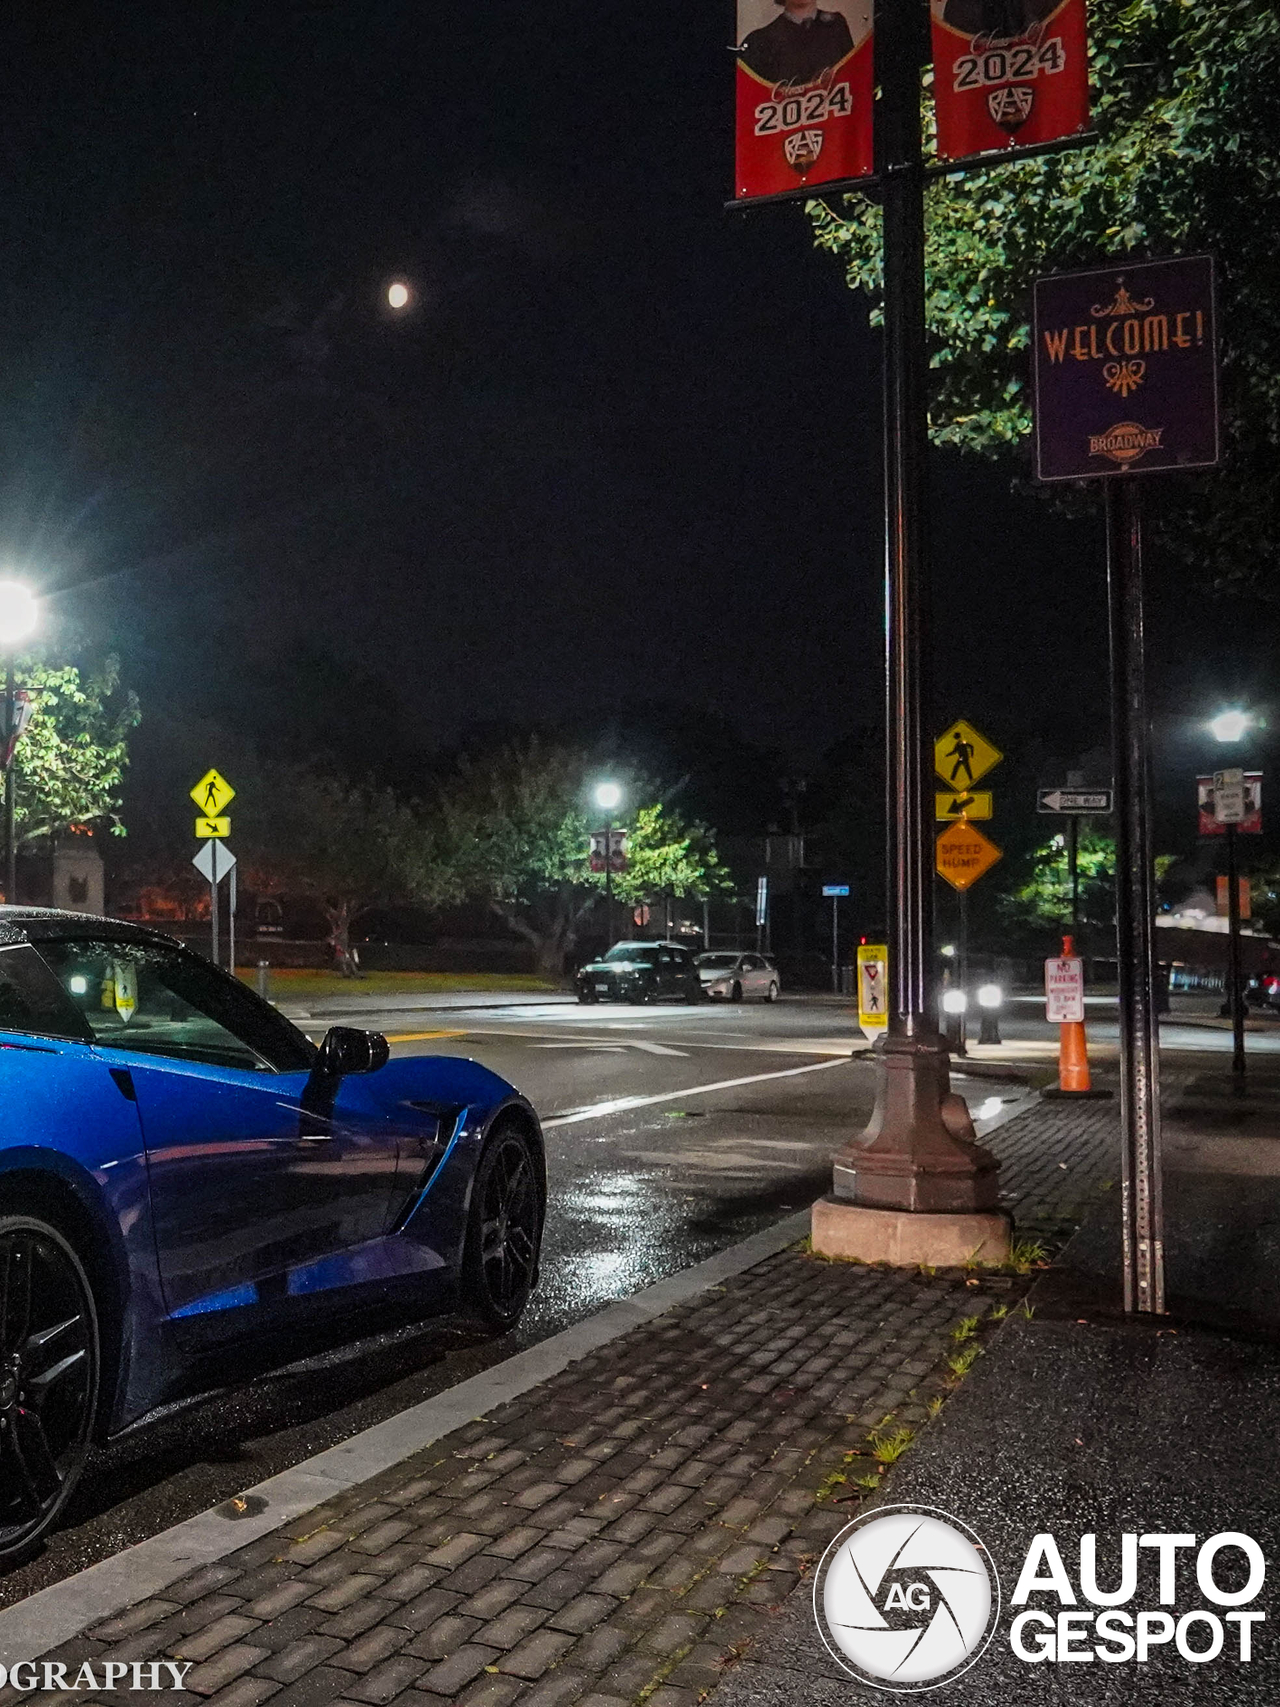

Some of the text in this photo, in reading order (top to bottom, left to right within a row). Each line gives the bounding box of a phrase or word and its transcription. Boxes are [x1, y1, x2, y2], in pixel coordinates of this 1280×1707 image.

[953, 37, 1066, 93] 2024
[754, 82, 853, 136] 2024
[1044, 310, 1204, 364] WELCOME!
[1089, 430, 1162, 452] BROADWAY
[1083, 795, 1107, 807] WAY
[942, 843, 982, 855] SPEED
[942, 857, 982, 868] HUMP
[1056, 963, 1071, 973] NO
[1049, 973, 1078, 984] PARKING
